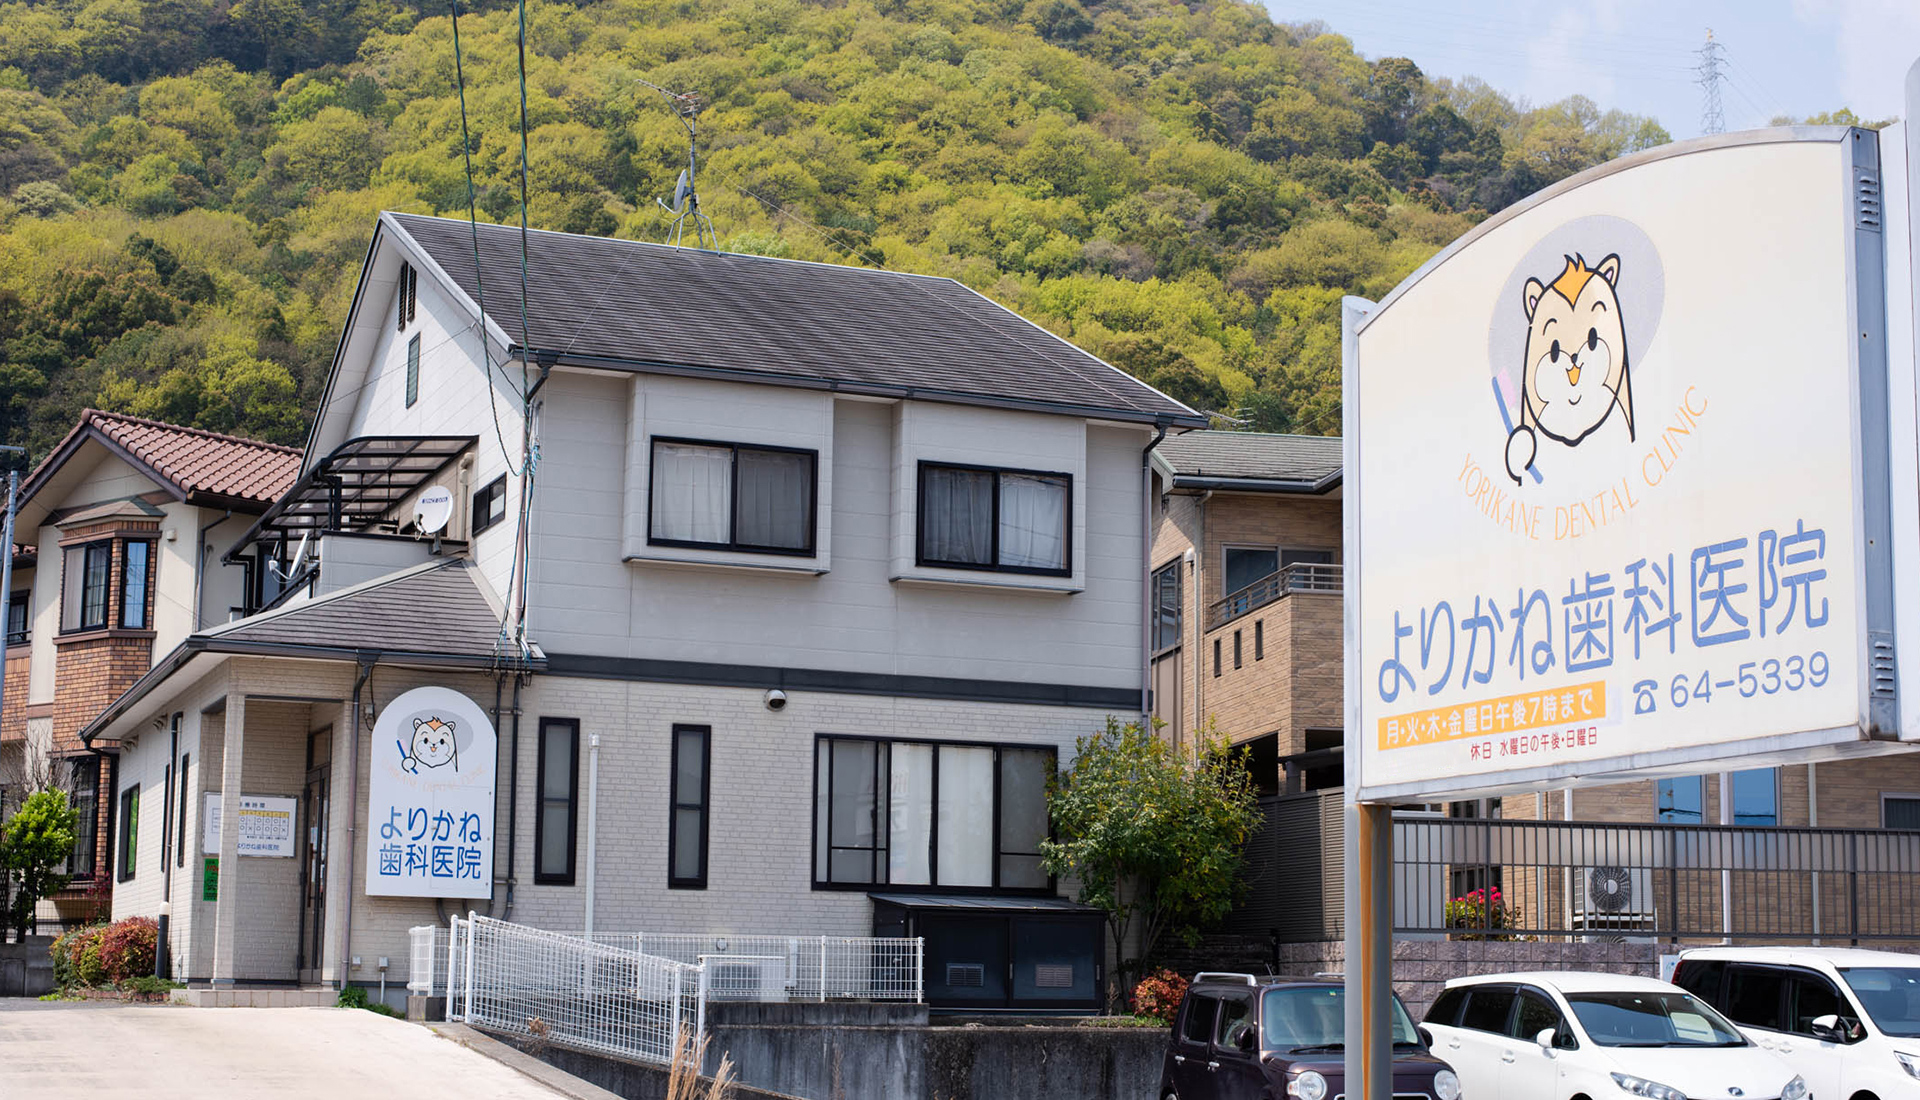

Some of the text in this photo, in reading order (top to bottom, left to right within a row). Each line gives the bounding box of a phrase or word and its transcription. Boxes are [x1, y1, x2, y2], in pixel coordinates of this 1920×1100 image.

[1458, 385, 1708, 541] YORIKANE DENTAL CLINIC
[1377, 518, 1830, 704] よりかね歯科医院
[1670, 650, 1830, 708] 64-5339
[1470, 741, 1492, 761] 休日
[380, 806, 482, 843] よりかね
[379, 842, 482, 879] 歯科医院
